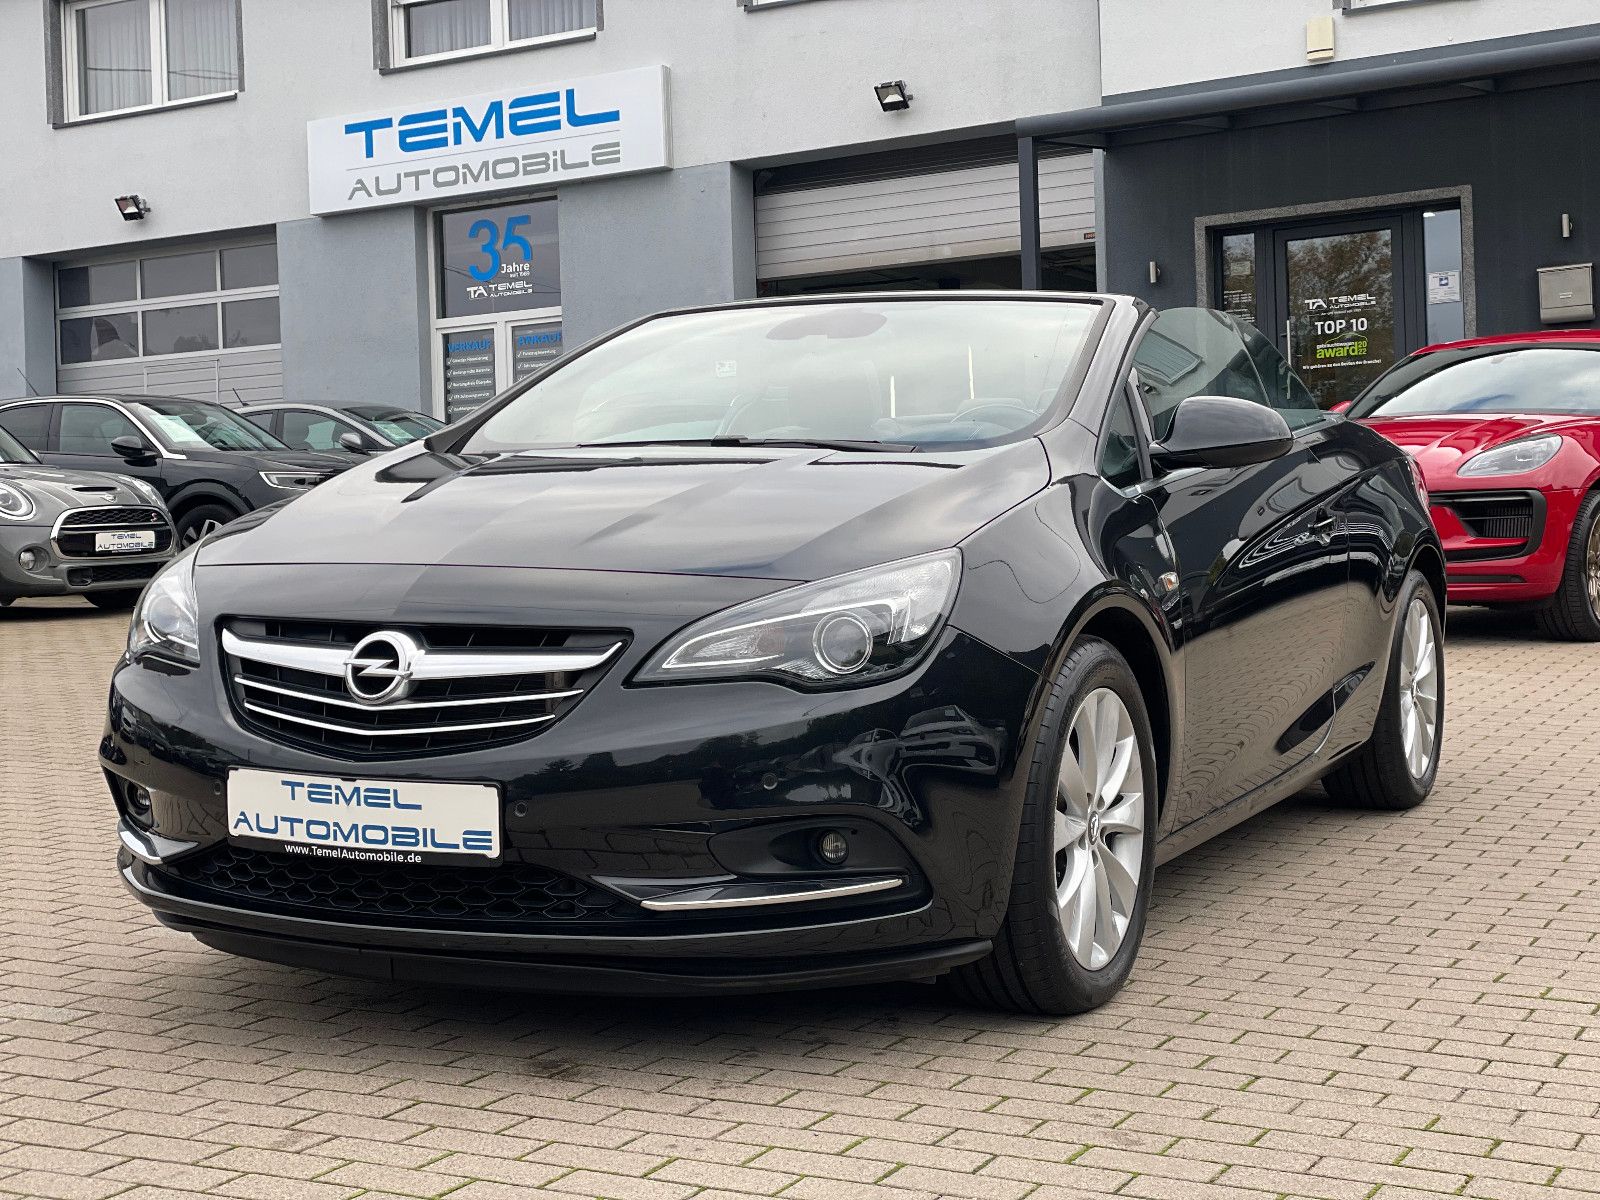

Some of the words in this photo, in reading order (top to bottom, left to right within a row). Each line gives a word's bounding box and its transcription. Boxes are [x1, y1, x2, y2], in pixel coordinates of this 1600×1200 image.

[345, 88, 620, 158] TEMEL
[468, 215, 533, 282] 35
[501, 262, 530, 274] Jahre
[466, 285, 488, 299] TA
[489, 280, 533, 291] TEMEL
[1304, 298, 1327, 310] TA
[1329, 293, 1376, 303] TEMEL
[1314, 319, 1346, 335] TOP
[1350, 317, 1368, 332] 10
[447, 339, 491, 353] VERKAUF
[518, 332, 561, 346] ANKAUF
[1358, 340, 1368, 348] 20
[1316, 341, 1358, 358] award
[97, 541, 154, 550] AUTOMOBILE
[280, 780, 422, 811] TEMEL
[233, 810, 493, 851] AUTOMOBILE
[285, 843, 422, 863] www.TemelAutomobile.de
